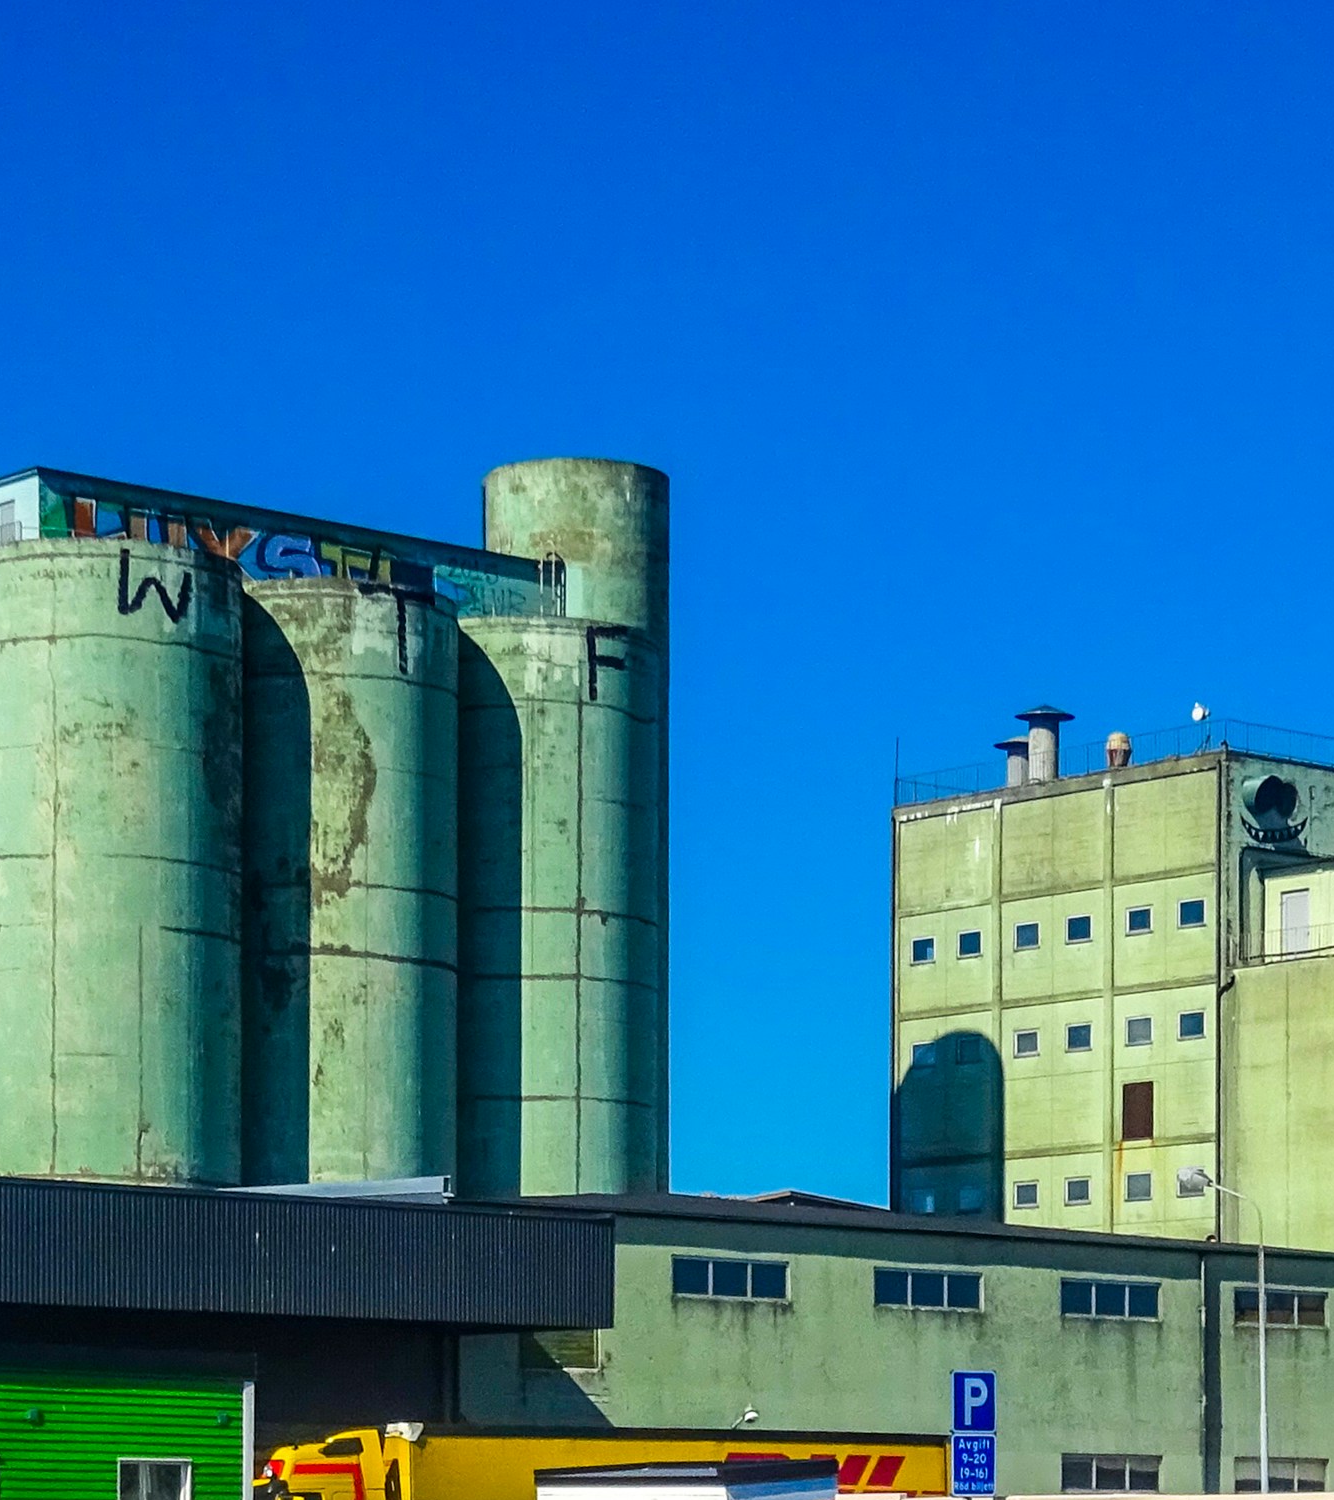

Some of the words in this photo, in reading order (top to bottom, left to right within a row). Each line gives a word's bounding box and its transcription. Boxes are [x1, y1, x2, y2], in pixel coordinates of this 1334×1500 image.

[117, 548, 195, 624] W
[587, 624, 631, 700] F
[964, 1378, 988, 1426] P
[959, 1438, 990, 1452] Avgift
[962, 1452, 987, 1464] 9-20
[960, 1467, 988, 1479] (9-16)
